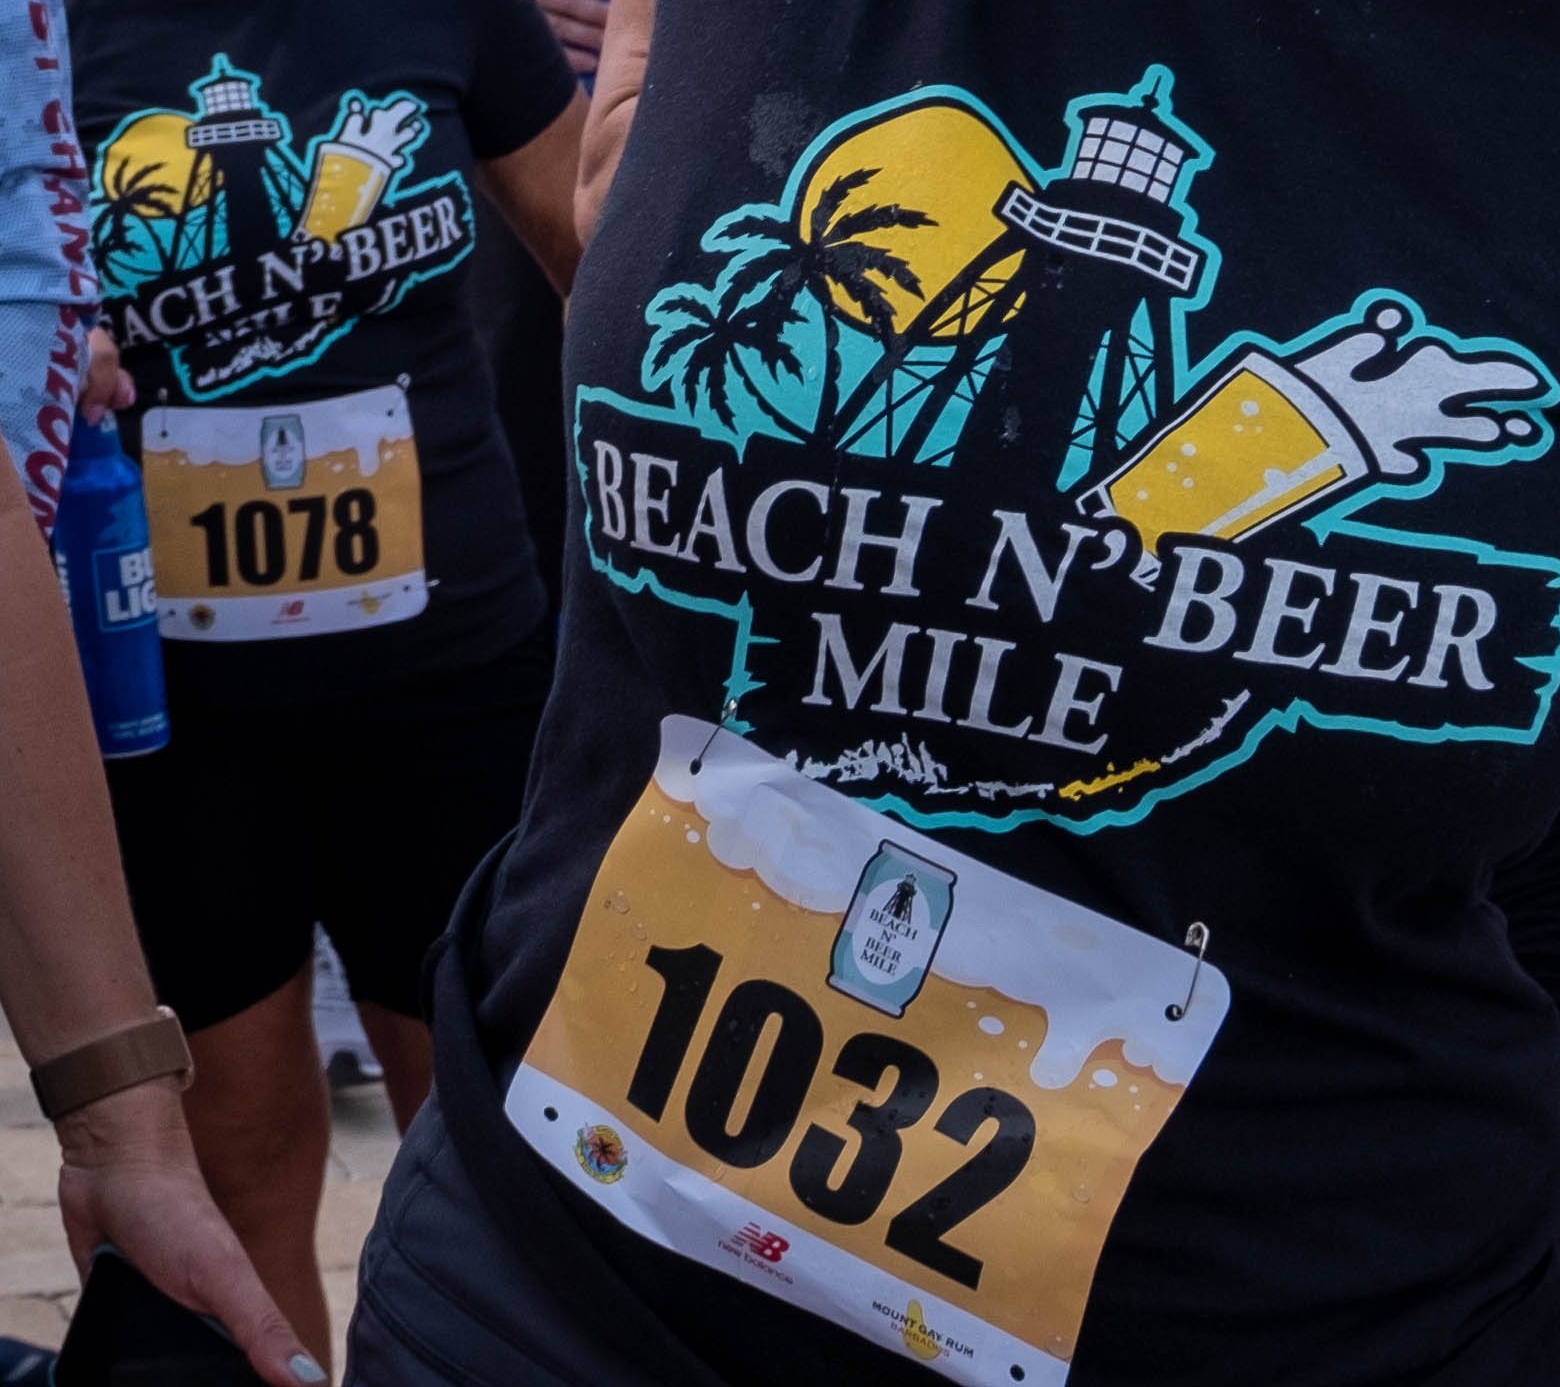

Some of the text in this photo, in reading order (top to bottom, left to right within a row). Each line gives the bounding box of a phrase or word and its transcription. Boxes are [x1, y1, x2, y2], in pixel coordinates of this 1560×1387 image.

[100, 264, 242, 349] EACH
[341, 195, 465, 283] BEER
[189, 487, 380, 588] 1078
[591, 436, 943, 598] BEACH
[1143, 545, 1498, 691] BEER
[119, 547, 155, 588] BU
[104, 579, 158, 623] LIG
[801, 612, 1124, 754] MILE
[864, 936, 902, 963] BEER
[868, 908, 918, 941] BEACH
[860, 948, 898, 975] MILE
[625, 942, 1037, 1292] 1032
[742, 1251, 794, 1285] balance
[871, 1299, 975, 1359] MOUNT GAY RUM
